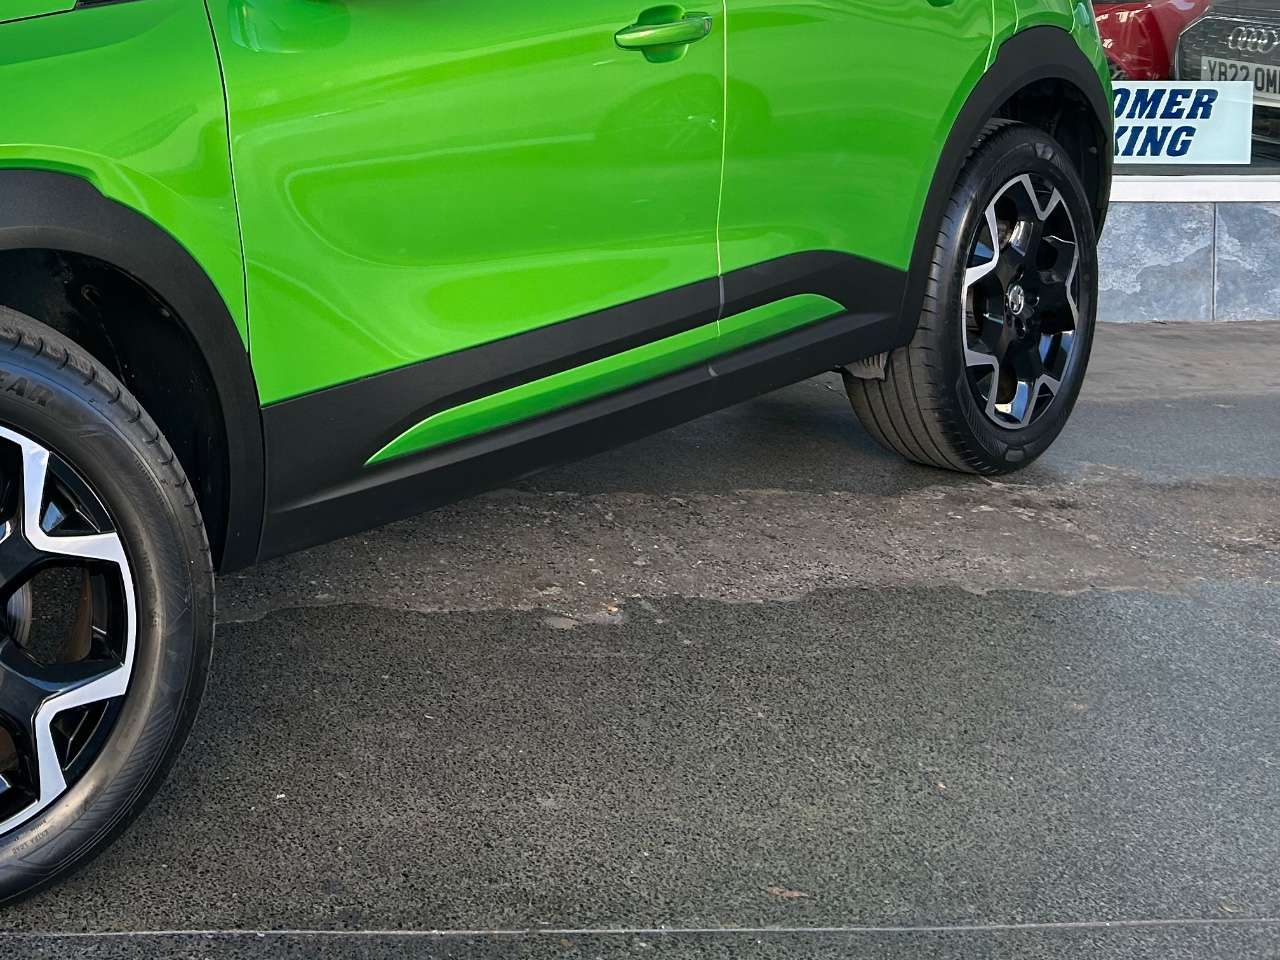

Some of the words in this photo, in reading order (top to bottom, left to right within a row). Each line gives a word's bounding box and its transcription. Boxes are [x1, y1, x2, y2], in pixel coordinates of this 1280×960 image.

[1207, 59, 1250, 81] YB22
[1254, 67, 1280, 94] OM
[1112, 87, 1219, 120] OMER
